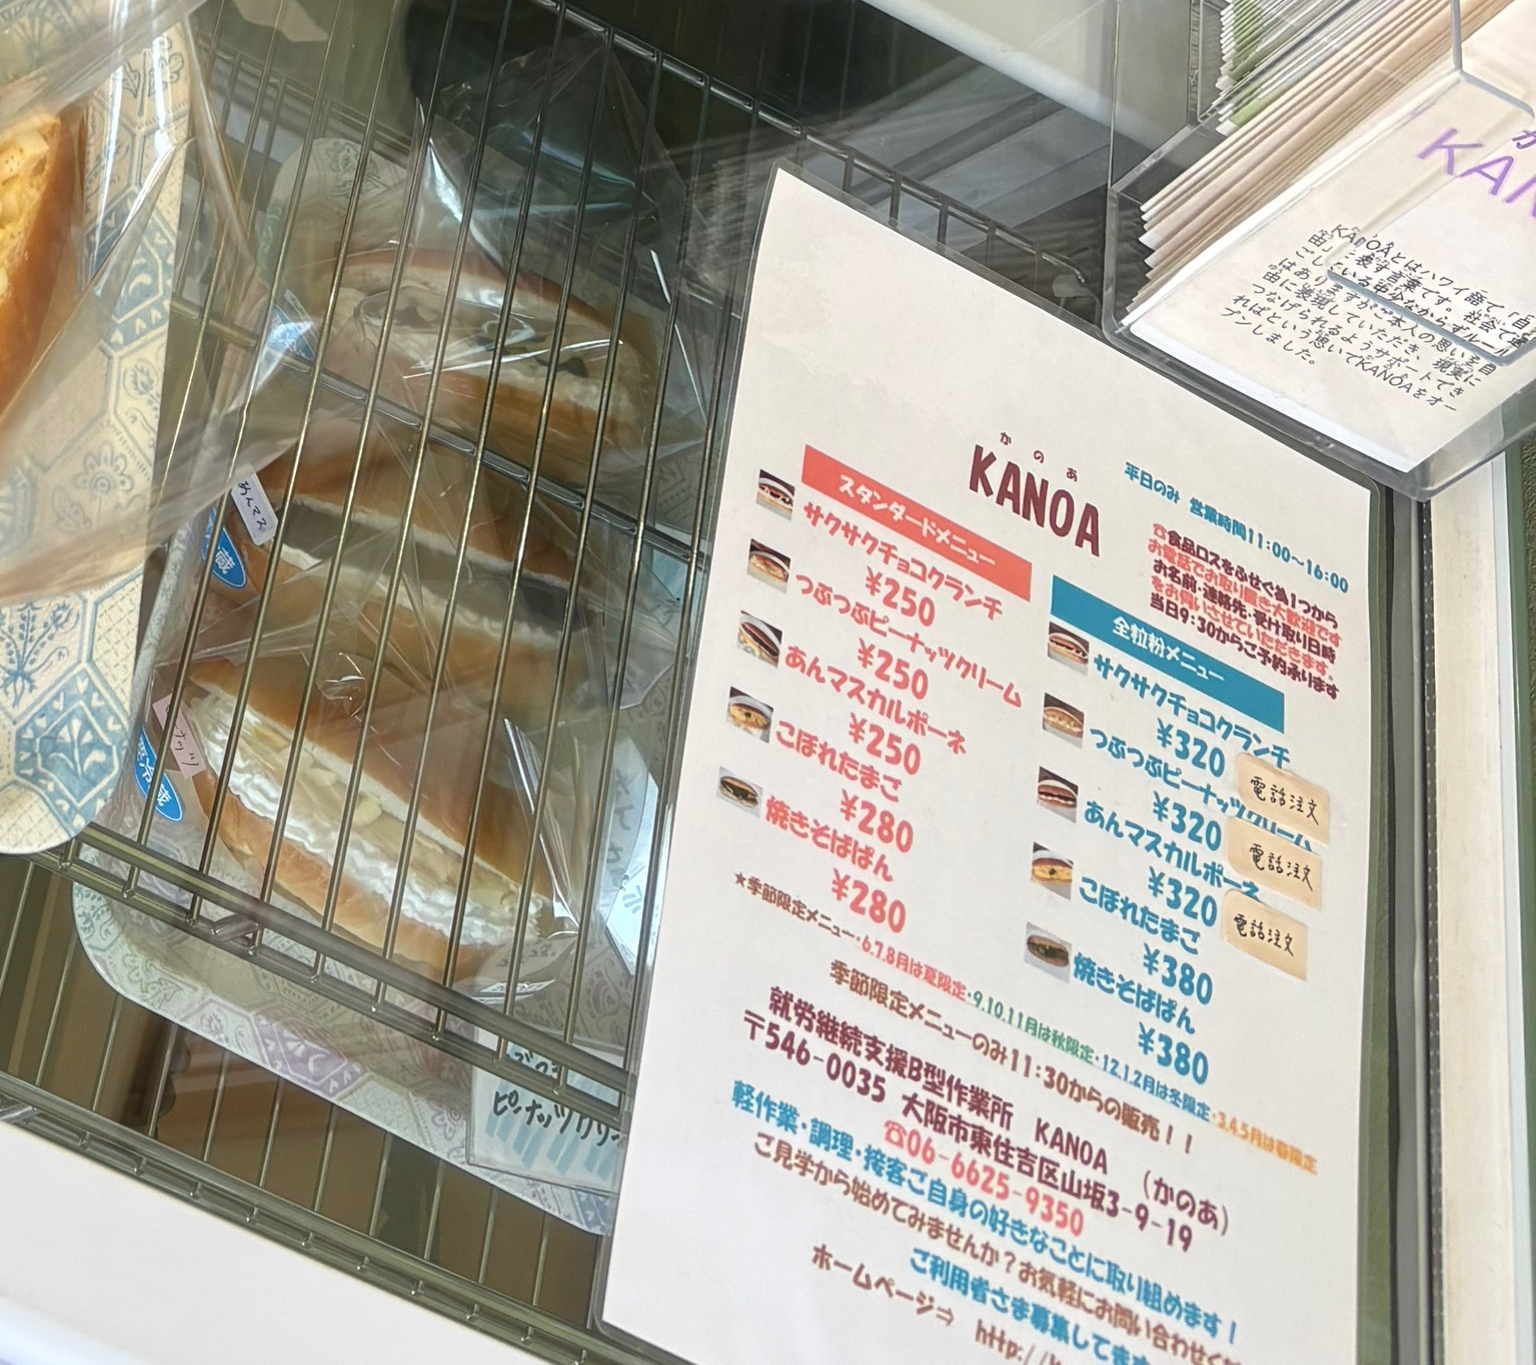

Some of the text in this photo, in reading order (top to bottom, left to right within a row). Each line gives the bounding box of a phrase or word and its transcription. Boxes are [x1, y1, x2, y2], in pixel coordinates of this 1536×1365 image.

[969, 444, 1100, 558] KANOA
[1124, 462, 1180, 504] 平日のみ
[839, 474, 996, 566] スタンダードメニュー
[804, 501, 1003, 621] サクサクチョコクランチ
[865, 566, 935, 627] ¥250
[795, 574, 1022, 708] つぶつぶピーナッツクリーム
[857, 637, 928, 701] ¥250
[1112, 615, 1225, 682] 全粒粉メニュー
[785, 644, 966, 756] あんマスカルポーネ
[1093, 654, 1290, 768] サクサクチョコクランチ
[848, 711, 921, 776] ¥250
[1156, 717, 1226, 778] ¥320
[840, 788, 914, 854] ¥280
[1152, 790, 1222, 852] ¥320
[1250, 775, 1320, 826] 電話注文
[765, 795, 894, 883] 焼きそばぱん
[1249, 843, 1314, 892] 電話注文
[831, 867, 906, 933] ¥280
[1147, 866, 1218, 928] ¥320
[1233, 913, 1295, 957] 電話注文
[1072, 951, 1196, 1035] 焼きそばぱん
[1142, 942, 1213, 1005] ¥380
[768, 985, 1015, 1131] 就労継続支援B型作業所
[1034, 1117, 1108, 1176] KANOA
[1137, 1021, 1209, 1085] ¥380
